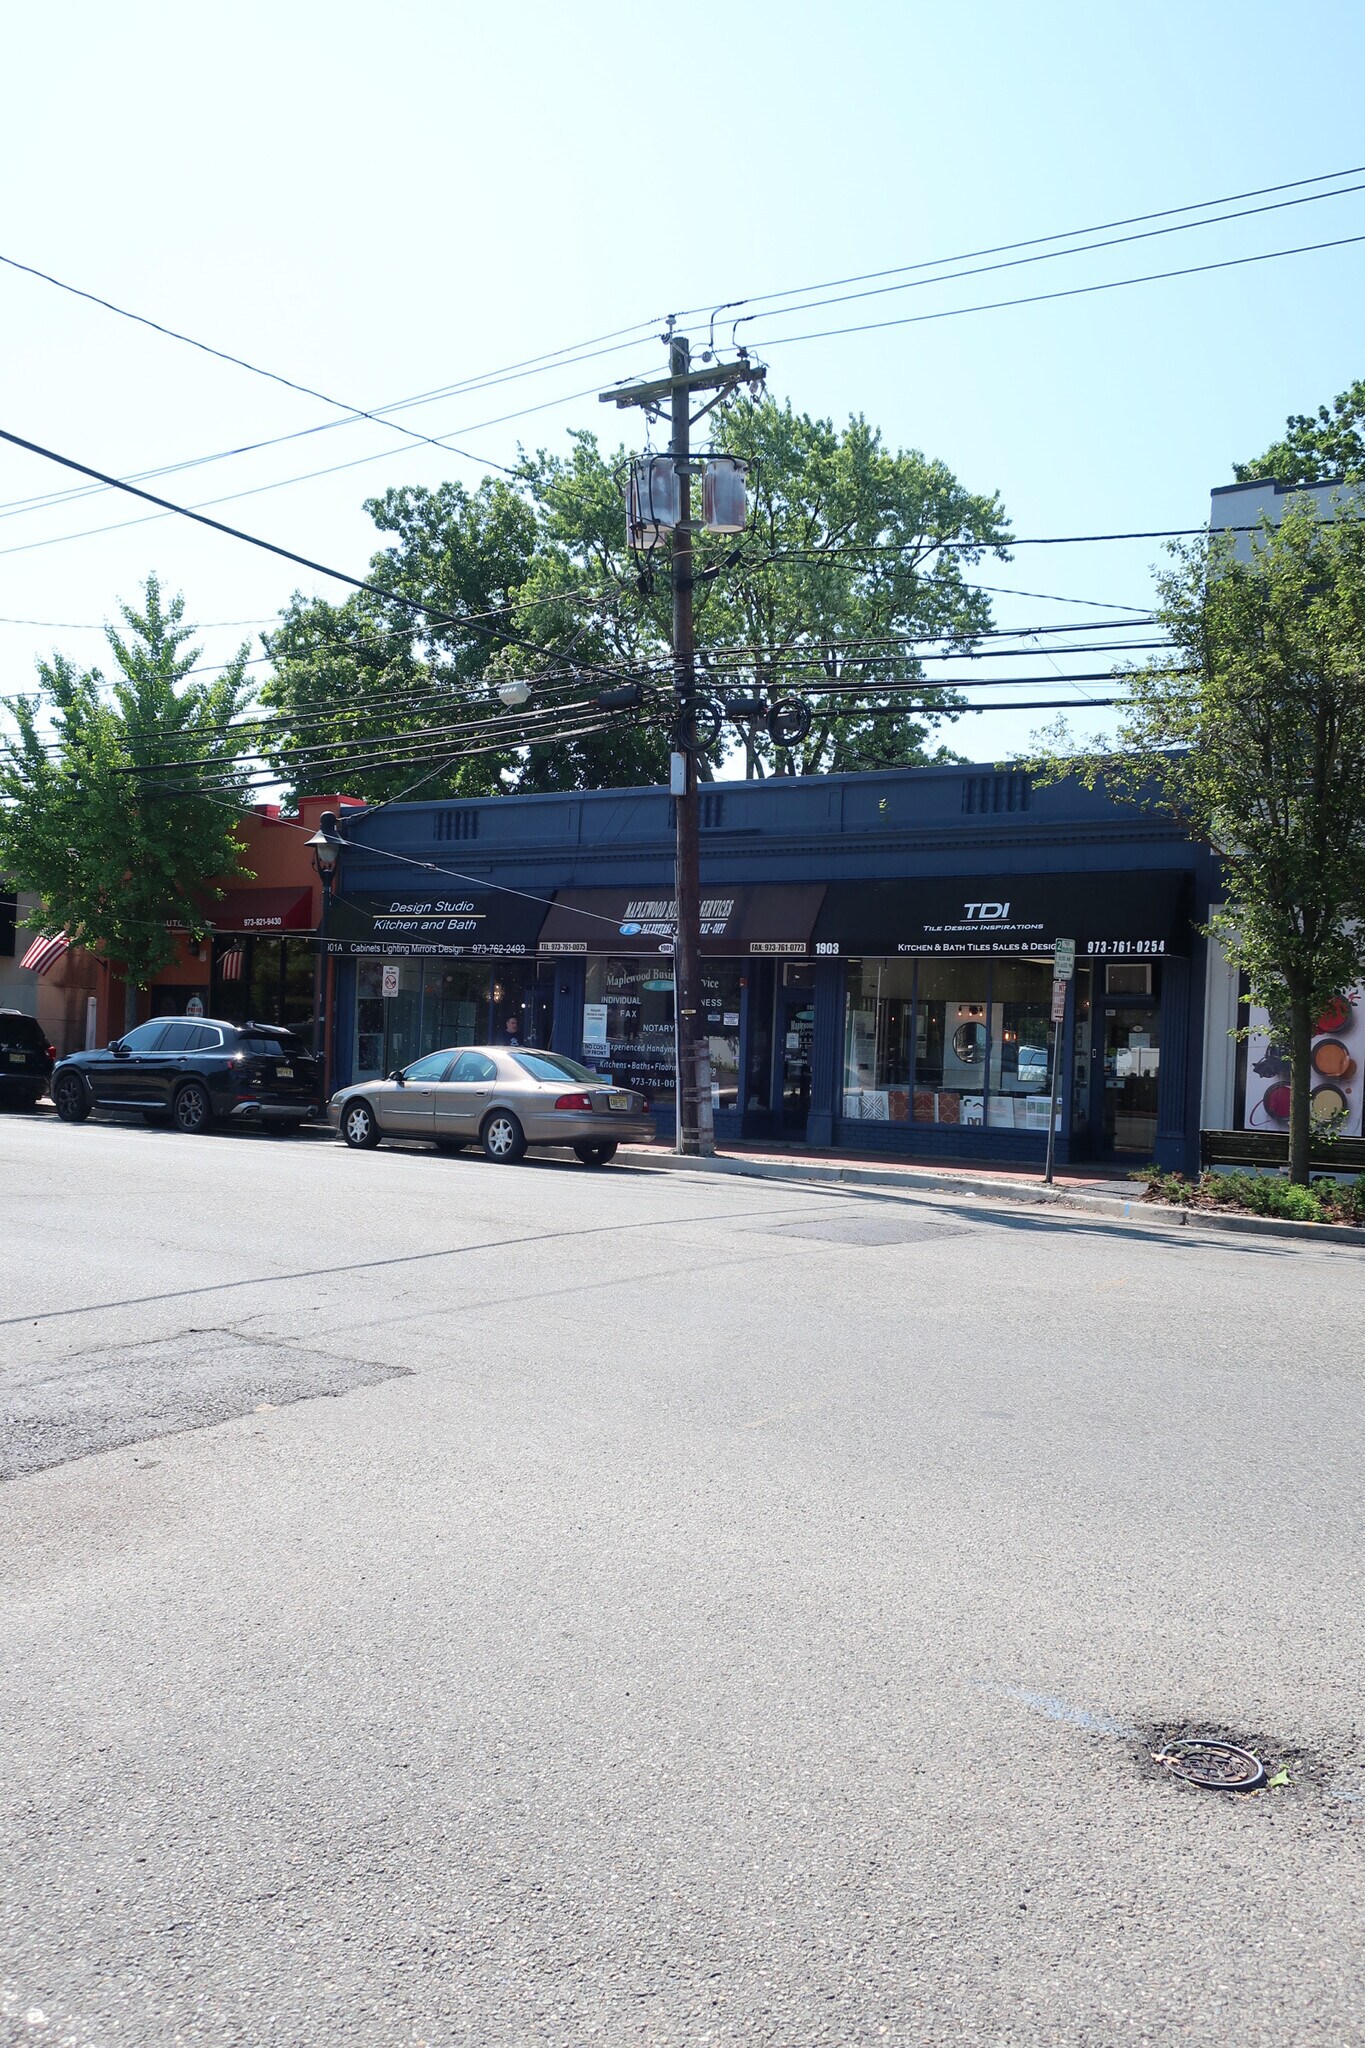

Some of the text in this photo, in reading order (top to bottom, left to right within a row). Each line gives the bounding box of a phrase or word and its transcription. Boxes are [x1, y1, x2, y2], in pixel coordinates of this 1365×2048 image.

[390, 901, 475, 914] Design Studio
[623, 901, 667, 918] MAPLEWOOD
[963, 902, 1010, 919] TDI
[243, 918, 281, 926] 973-821-9430
[373, 920, 477, 930] Kitchen and Bath
[350, 943, 381, 953] Cabinets
[382, 943, 410, 955] Lighting
[411, 944, 437, 953] Mirrors
[438, 945, 464, 955] Design
[472, 944, 526, 954] 973-762-2493
[764, 943, 805, 951] 973-761-0773
[815, 943, 840, 954] 1903
[898, 942, 1056, 951] KITCHEN & BATH TILES SALES & DESIG
[1056, 941, 1062, 951] 2
[1087, 940, 1165, 953] 973-761-0254
[606, 968, 719, 988] Maplewood Busin vice
[601, 996, 642, 1005] INDIVIDUAL
[620, 1010, 637, 1018] FAX
[643, 1024, 675, 1032] NOTARY
[610, 1043, 645, 1053] xperienced
[600, 1060, 678, 1071] Kitchens Baths Floorin
[630, 1077, 675, 1087] 973-761-00
